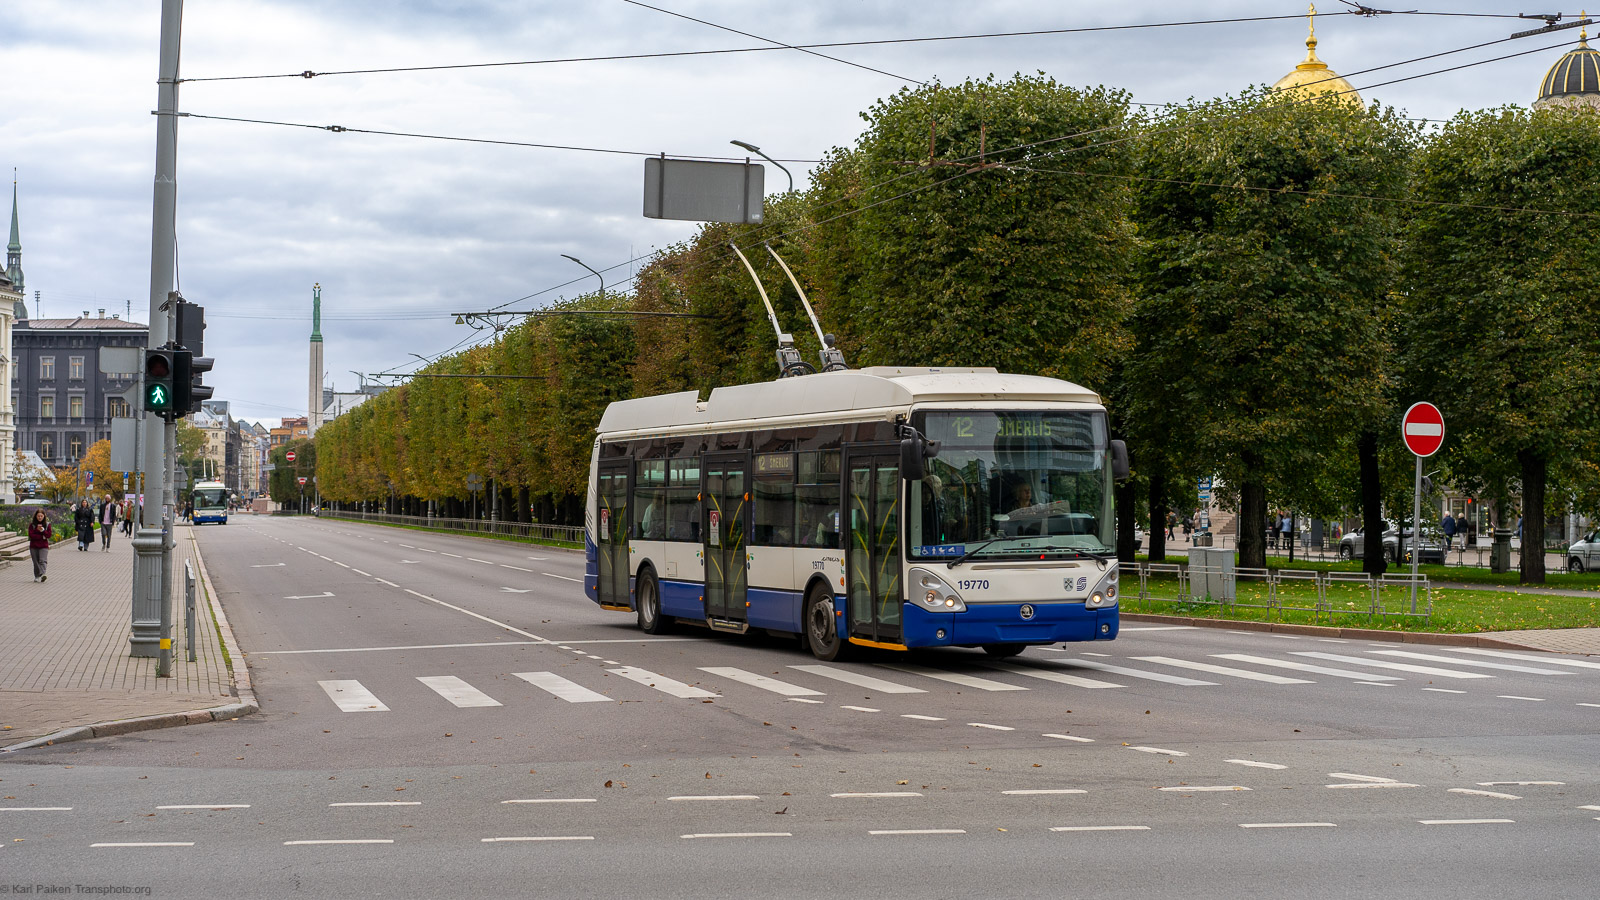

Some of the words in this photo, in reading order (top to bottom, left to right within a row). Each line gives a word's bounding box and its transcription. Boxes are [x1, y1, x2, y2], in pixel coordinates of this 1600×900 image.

[952, 417, 974, 437] 12
[997, 416, 1052, 436] ŠMERLIS
[758, 455, 766, 470] 12
[957, 579, 990, 590] 19770
